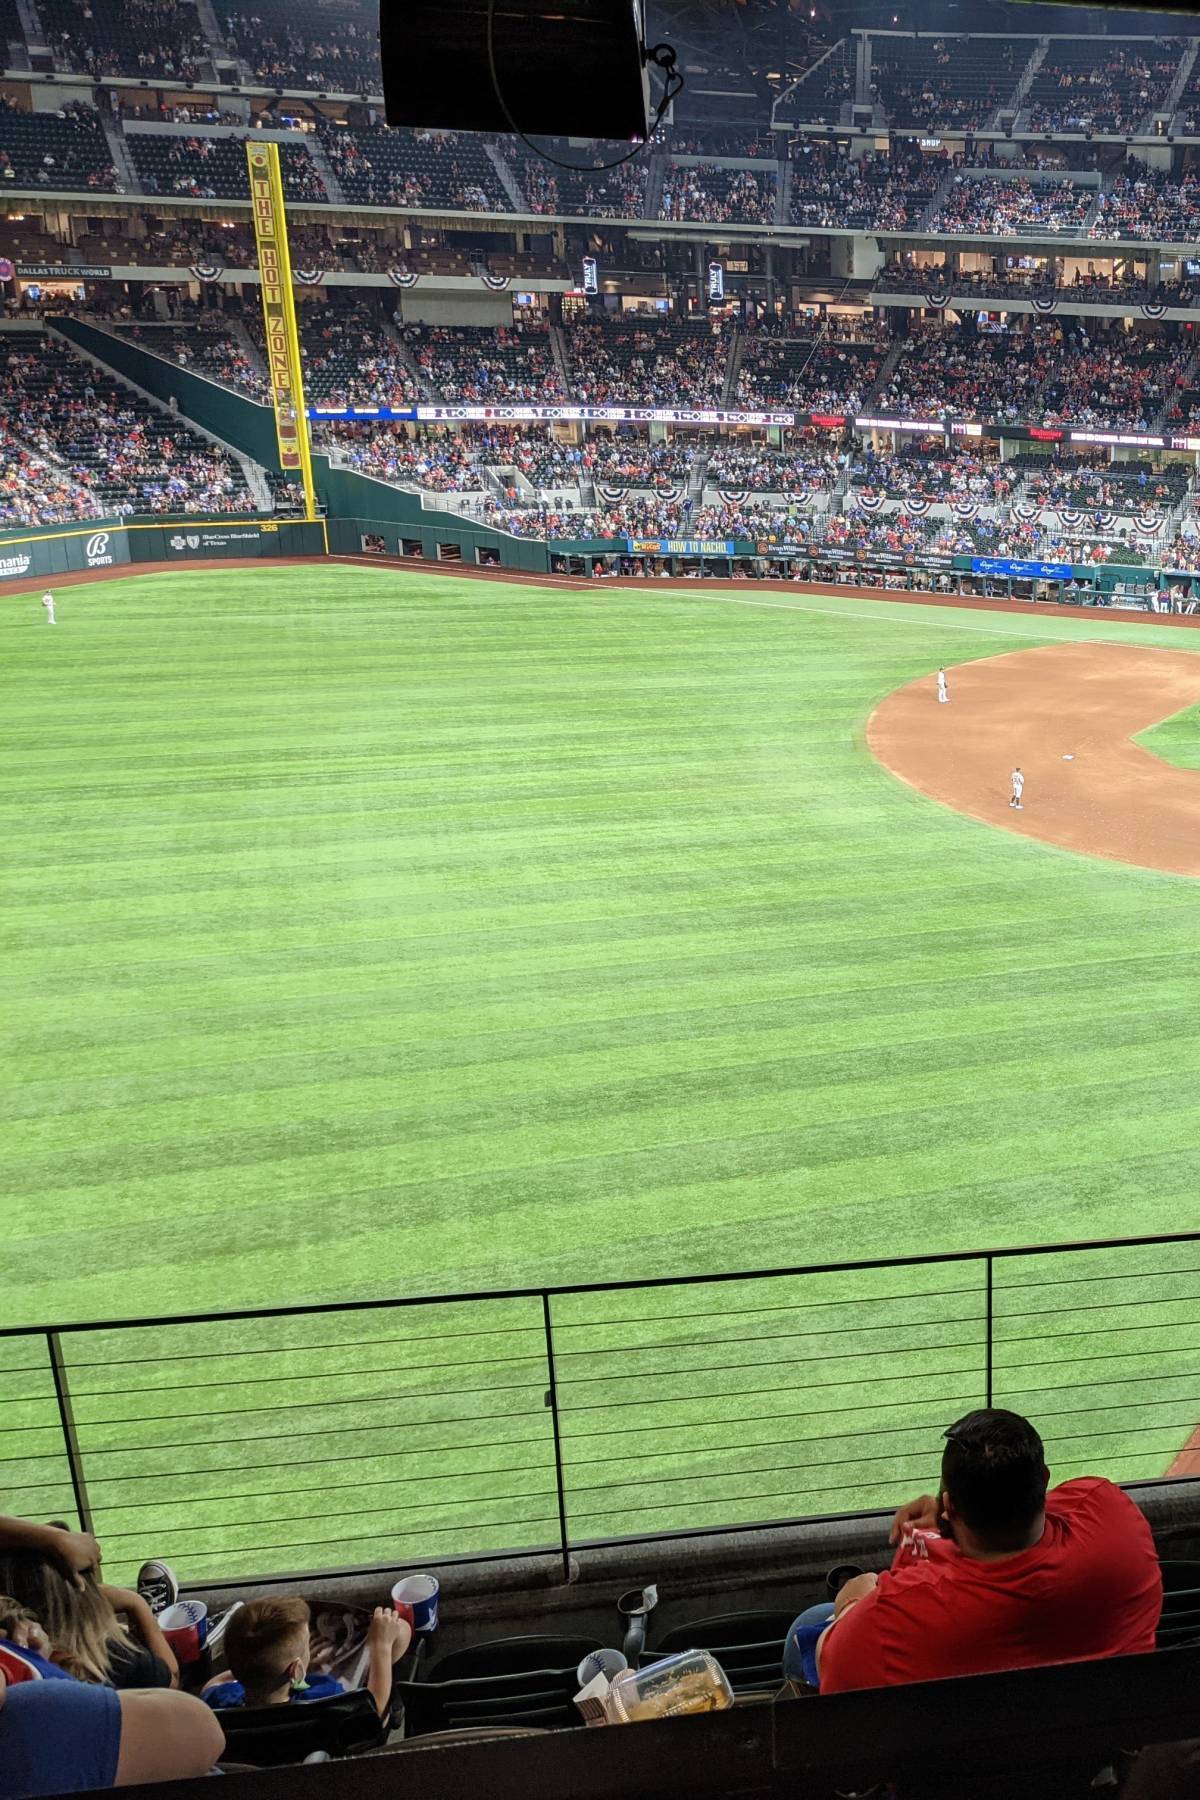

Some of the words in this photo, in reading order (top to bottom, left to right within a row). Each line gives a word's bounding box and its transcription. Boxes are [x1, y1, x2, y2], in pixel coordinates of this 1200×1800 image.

[256, 181, 271, 234] THE
[48, 267, 80, 276] TRUCK
[263, 250, 278, 302] HOT
[271, 318, 287, 387] ZONE
[260, 524, 278, 532] 326
[668, 541, 686, 552] HOW
[690, 541, 700, 552] TO
[88, 556, 112, 566] SPORTS
